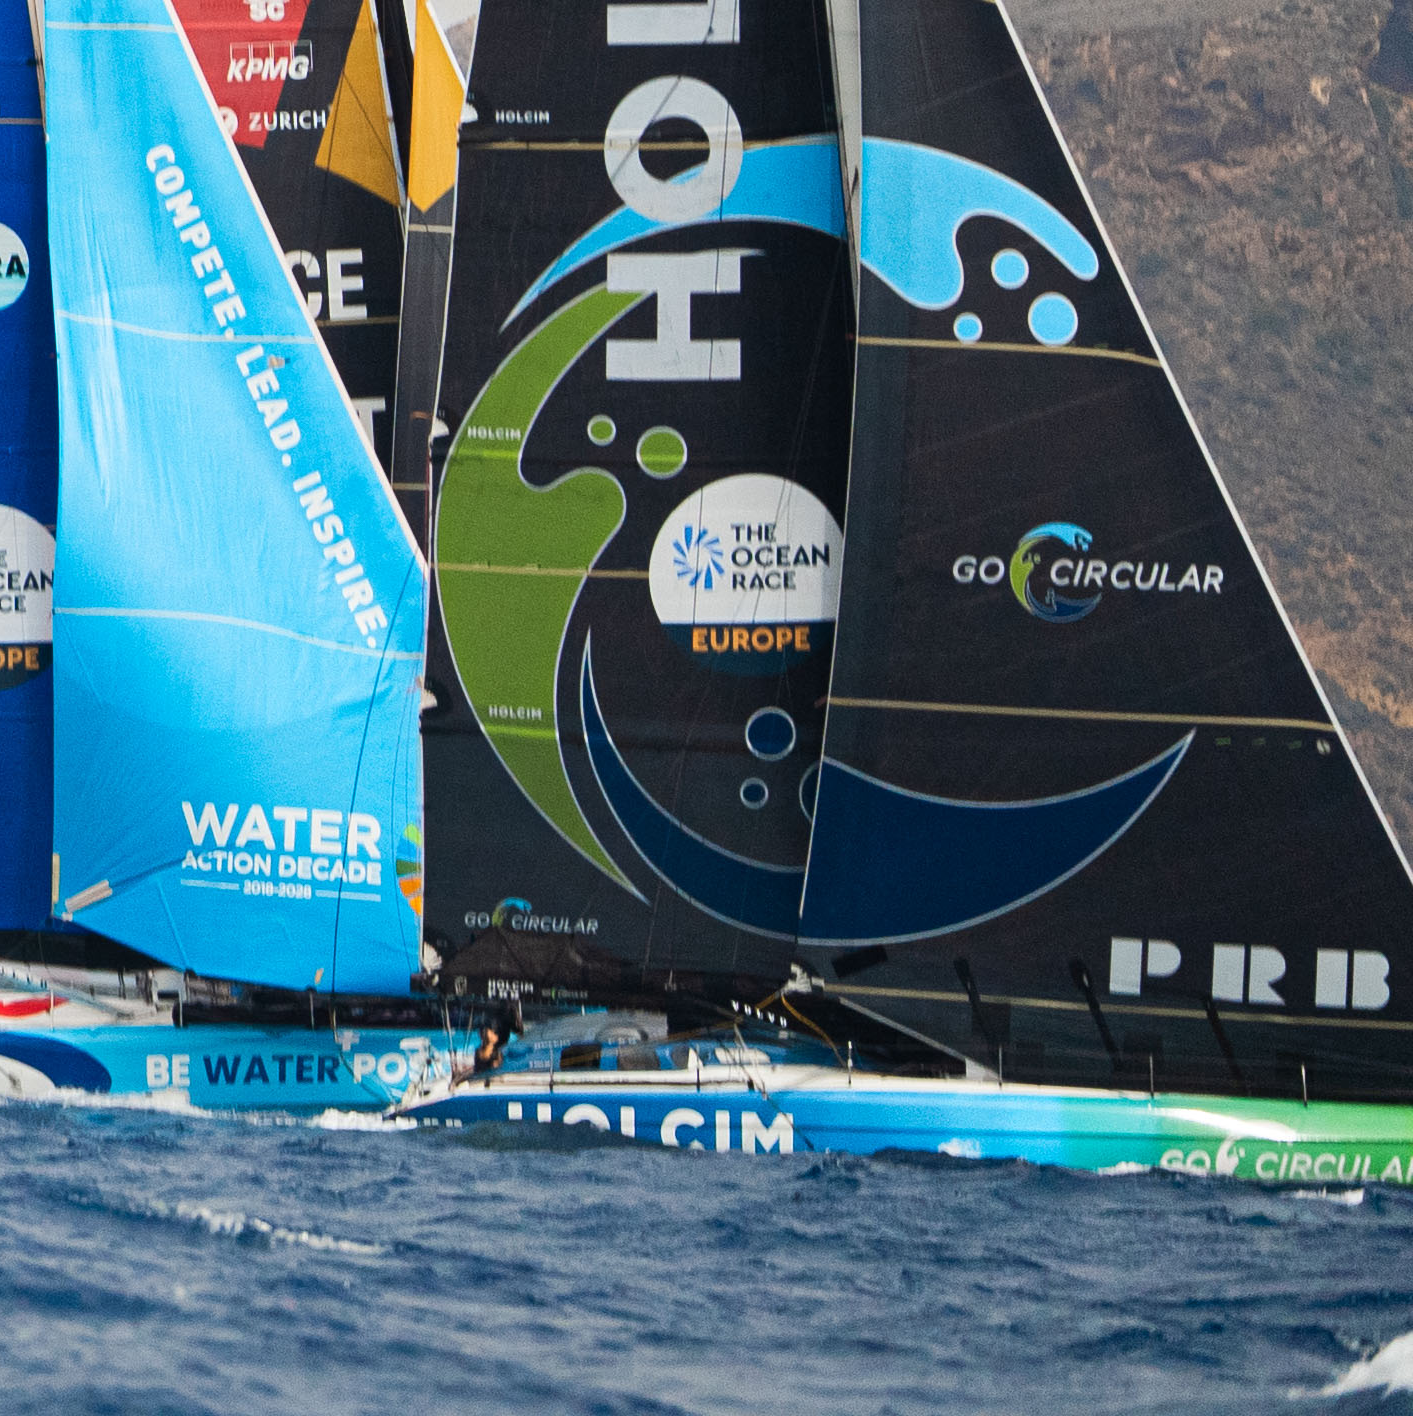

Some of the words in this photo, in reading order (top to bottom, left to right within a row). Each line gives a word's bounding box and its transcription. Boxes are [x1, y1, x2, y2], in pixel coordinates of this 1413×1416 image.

[227, 55, 310, 83] KPMG
[248, 109, 327, 132] ZURICH
[495, 109, 550, 125] HOLCIM
[145, 144, 245, 340] COMPETE.
[236, 344, 301, 467] LEAD.
[293, 471, 386, 648] INSPIRE.
[467, 425, 521, 441] HOLCIM
[730, 523, 776, 543] THE
[731, 543, 830, 568] OCEAN
[732, 570, 797, 592] RACE
[952, 555, 1005, 585] GO
[1049, 557, 1225, 594] CIRCULAR
[692, 625, 811, 653] EUROPE
[488, 704, 542, 721] HOLCIM
[181, 800, 381, 860] WATER
[181, 850, 272, 877] ACTION
[278, 855, 382, 886] DECADE
[464, 911, 490, 929] GO
[511, 913, 599, 935] CIRCULAR
[145, 1053, 191, 1087] BE
[202, 1054, 341, 1085] WATER
[1159, 1148, 1212, 1173] GO
[1255, 1150, 1413, 1184] CIRCULA
